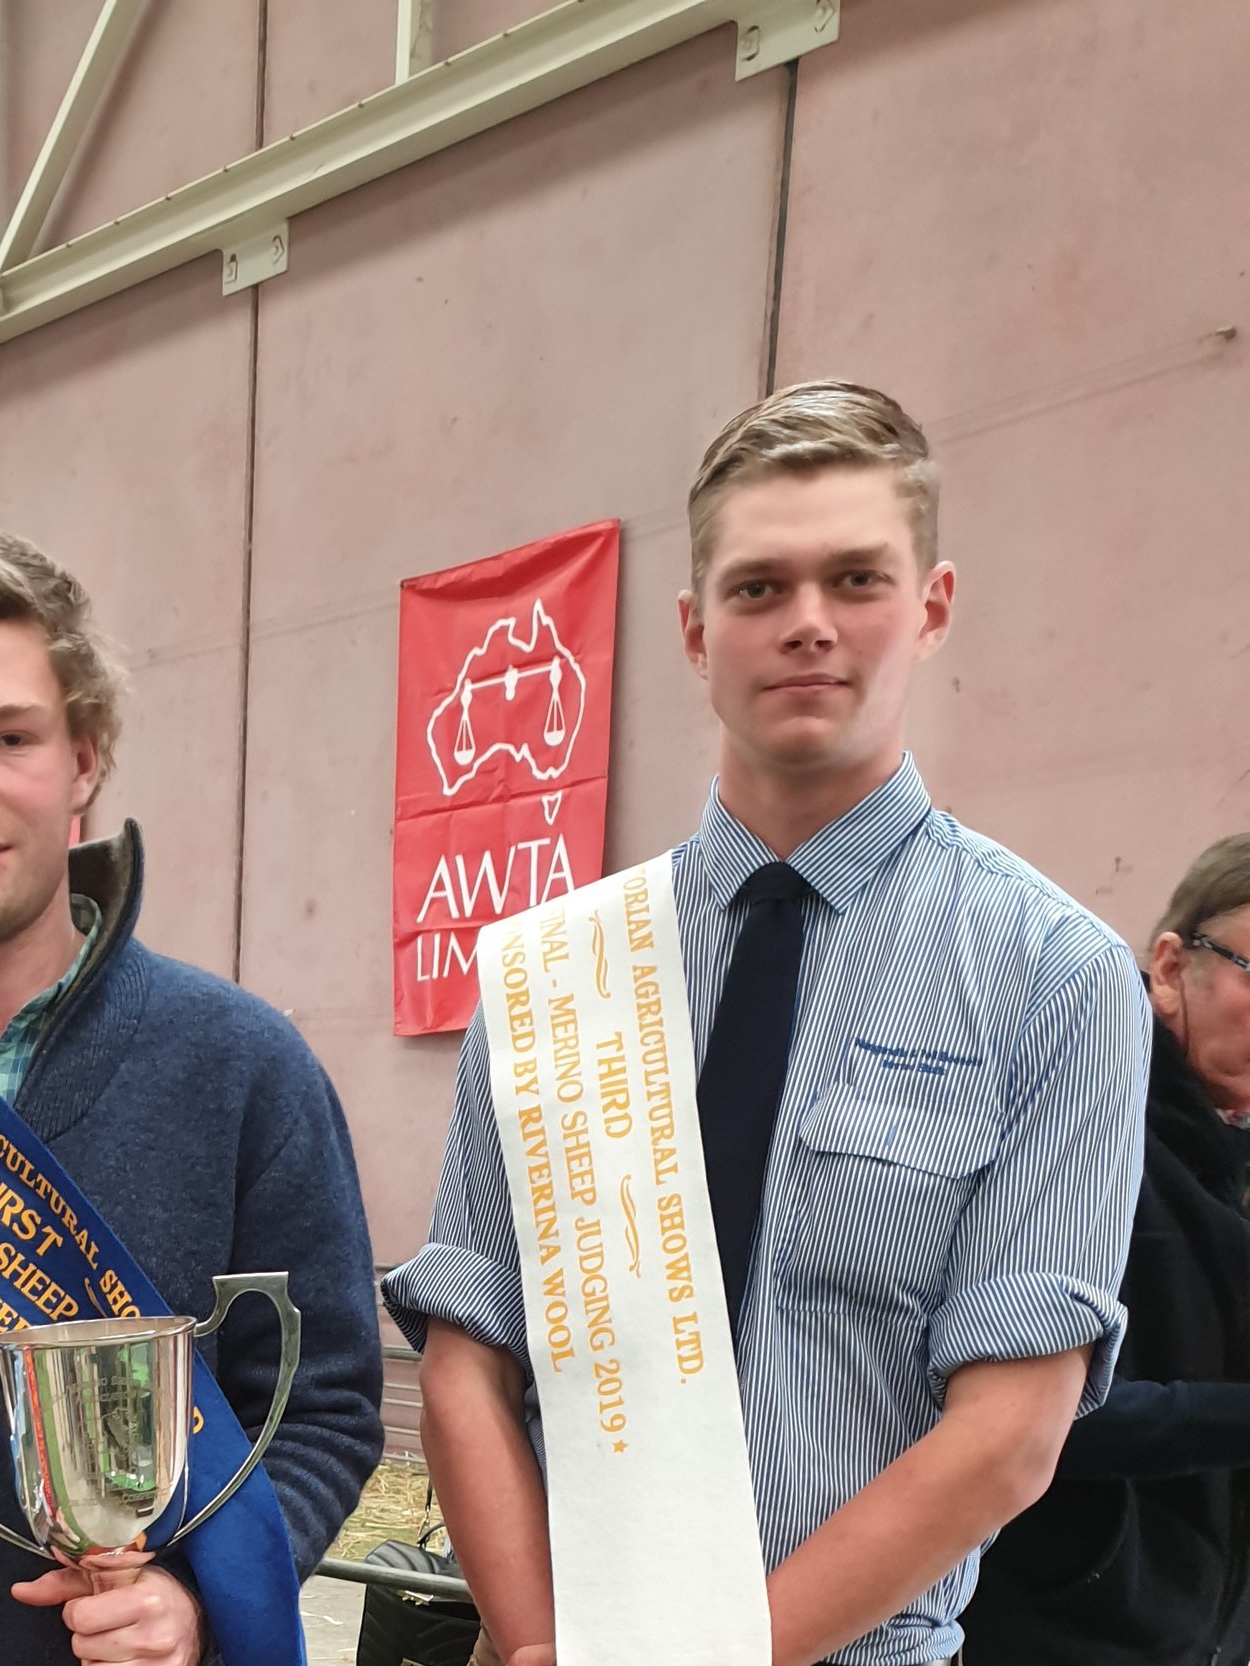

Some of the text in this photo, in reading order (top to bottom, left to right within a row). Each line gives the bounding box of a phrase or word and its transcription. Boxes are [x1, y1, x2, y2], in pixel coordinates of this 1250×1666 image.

[416, 832, 575, 923] AWTA
[512, 1056, 543, 1097] BY
[547, 993, 585, 1104] MERINO
[595, 1030, 634, 1140] THIRD
[631, 964, 678, 1187] AGRICULTURAL
[516, 1105, 563, 1269] RIVERINA
[560, 1109, 599, 1208] SHEEP
[574, 1214, 617, 1353] JUDGING
[656, 1193, 695, 1304] SHOWS
[538, 1269, 577, 1374] WOOL
[672, 1312, 706, 1386] LTD.
[593, 1355, 629, 1434] 2019
